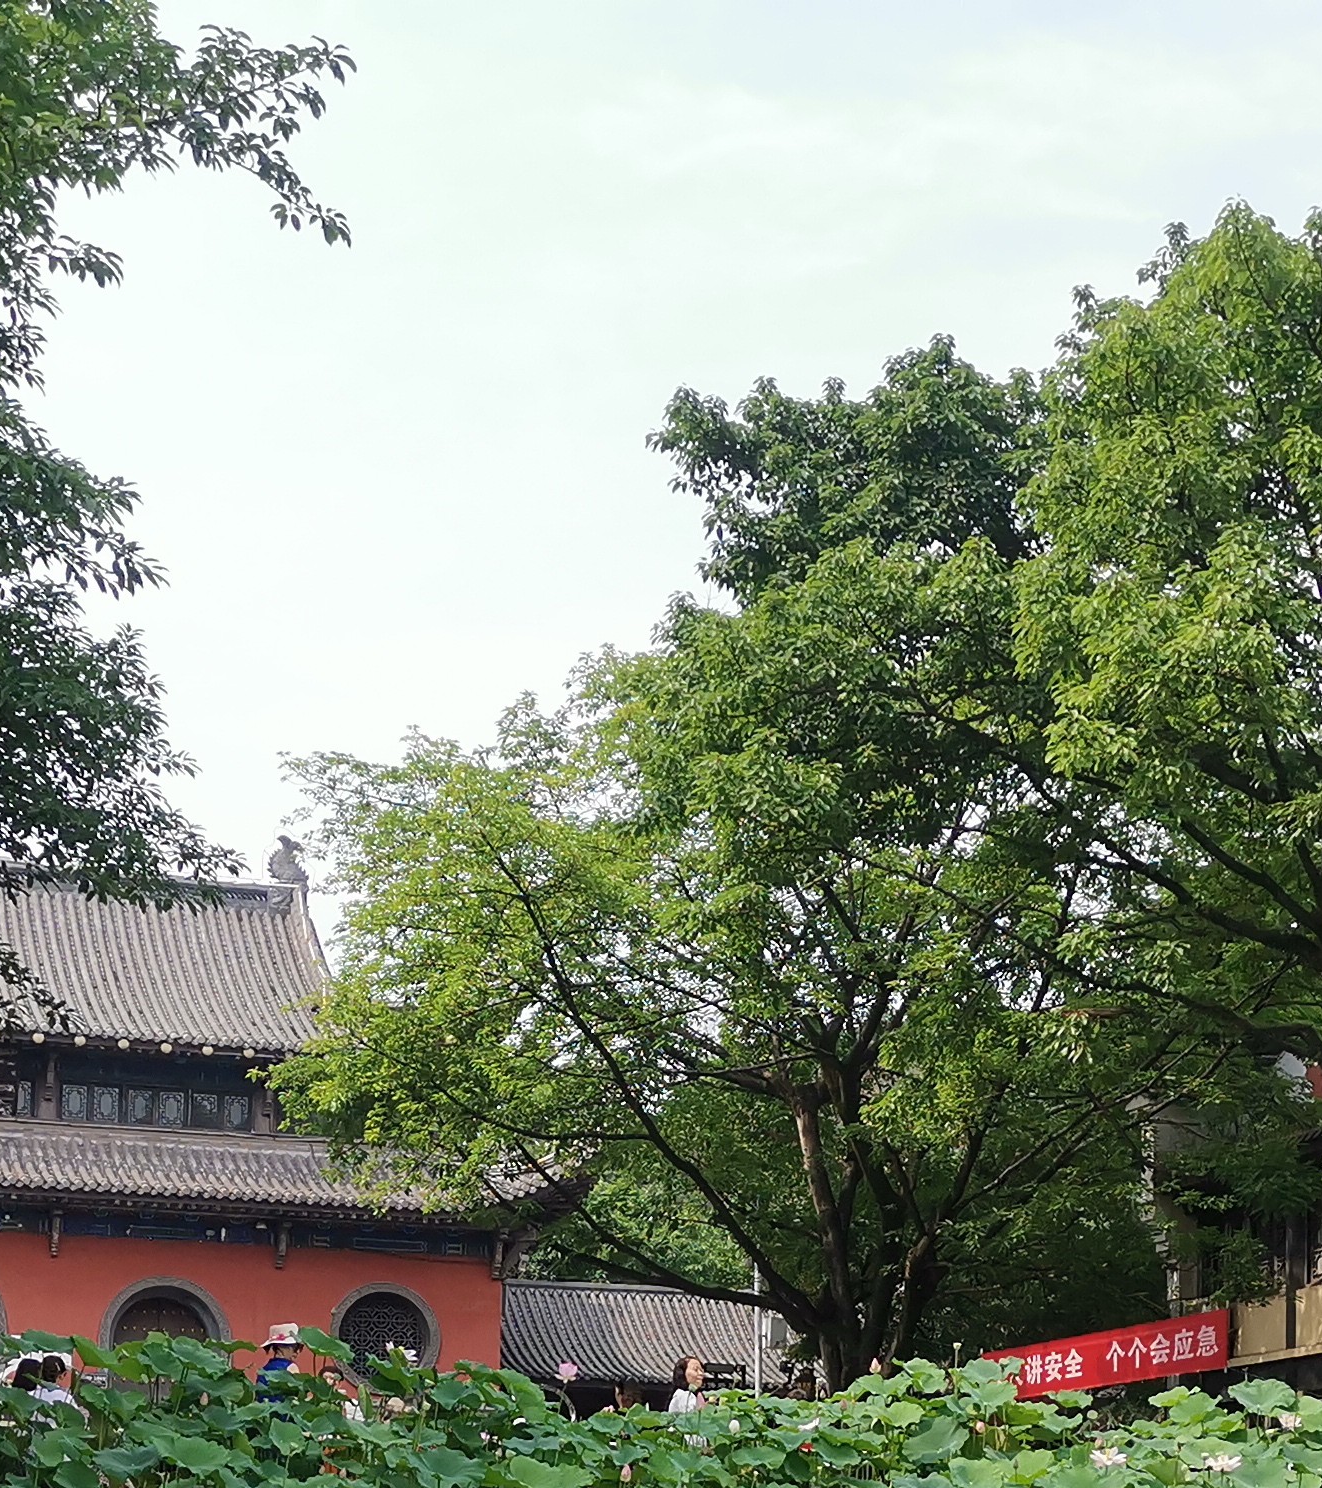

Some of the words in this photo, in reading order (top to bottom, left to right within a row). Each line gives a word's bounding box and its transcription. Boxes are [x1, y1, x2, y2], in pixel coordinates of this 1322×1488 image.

[1105, 1324, 1219, 1373] 个个会应急
